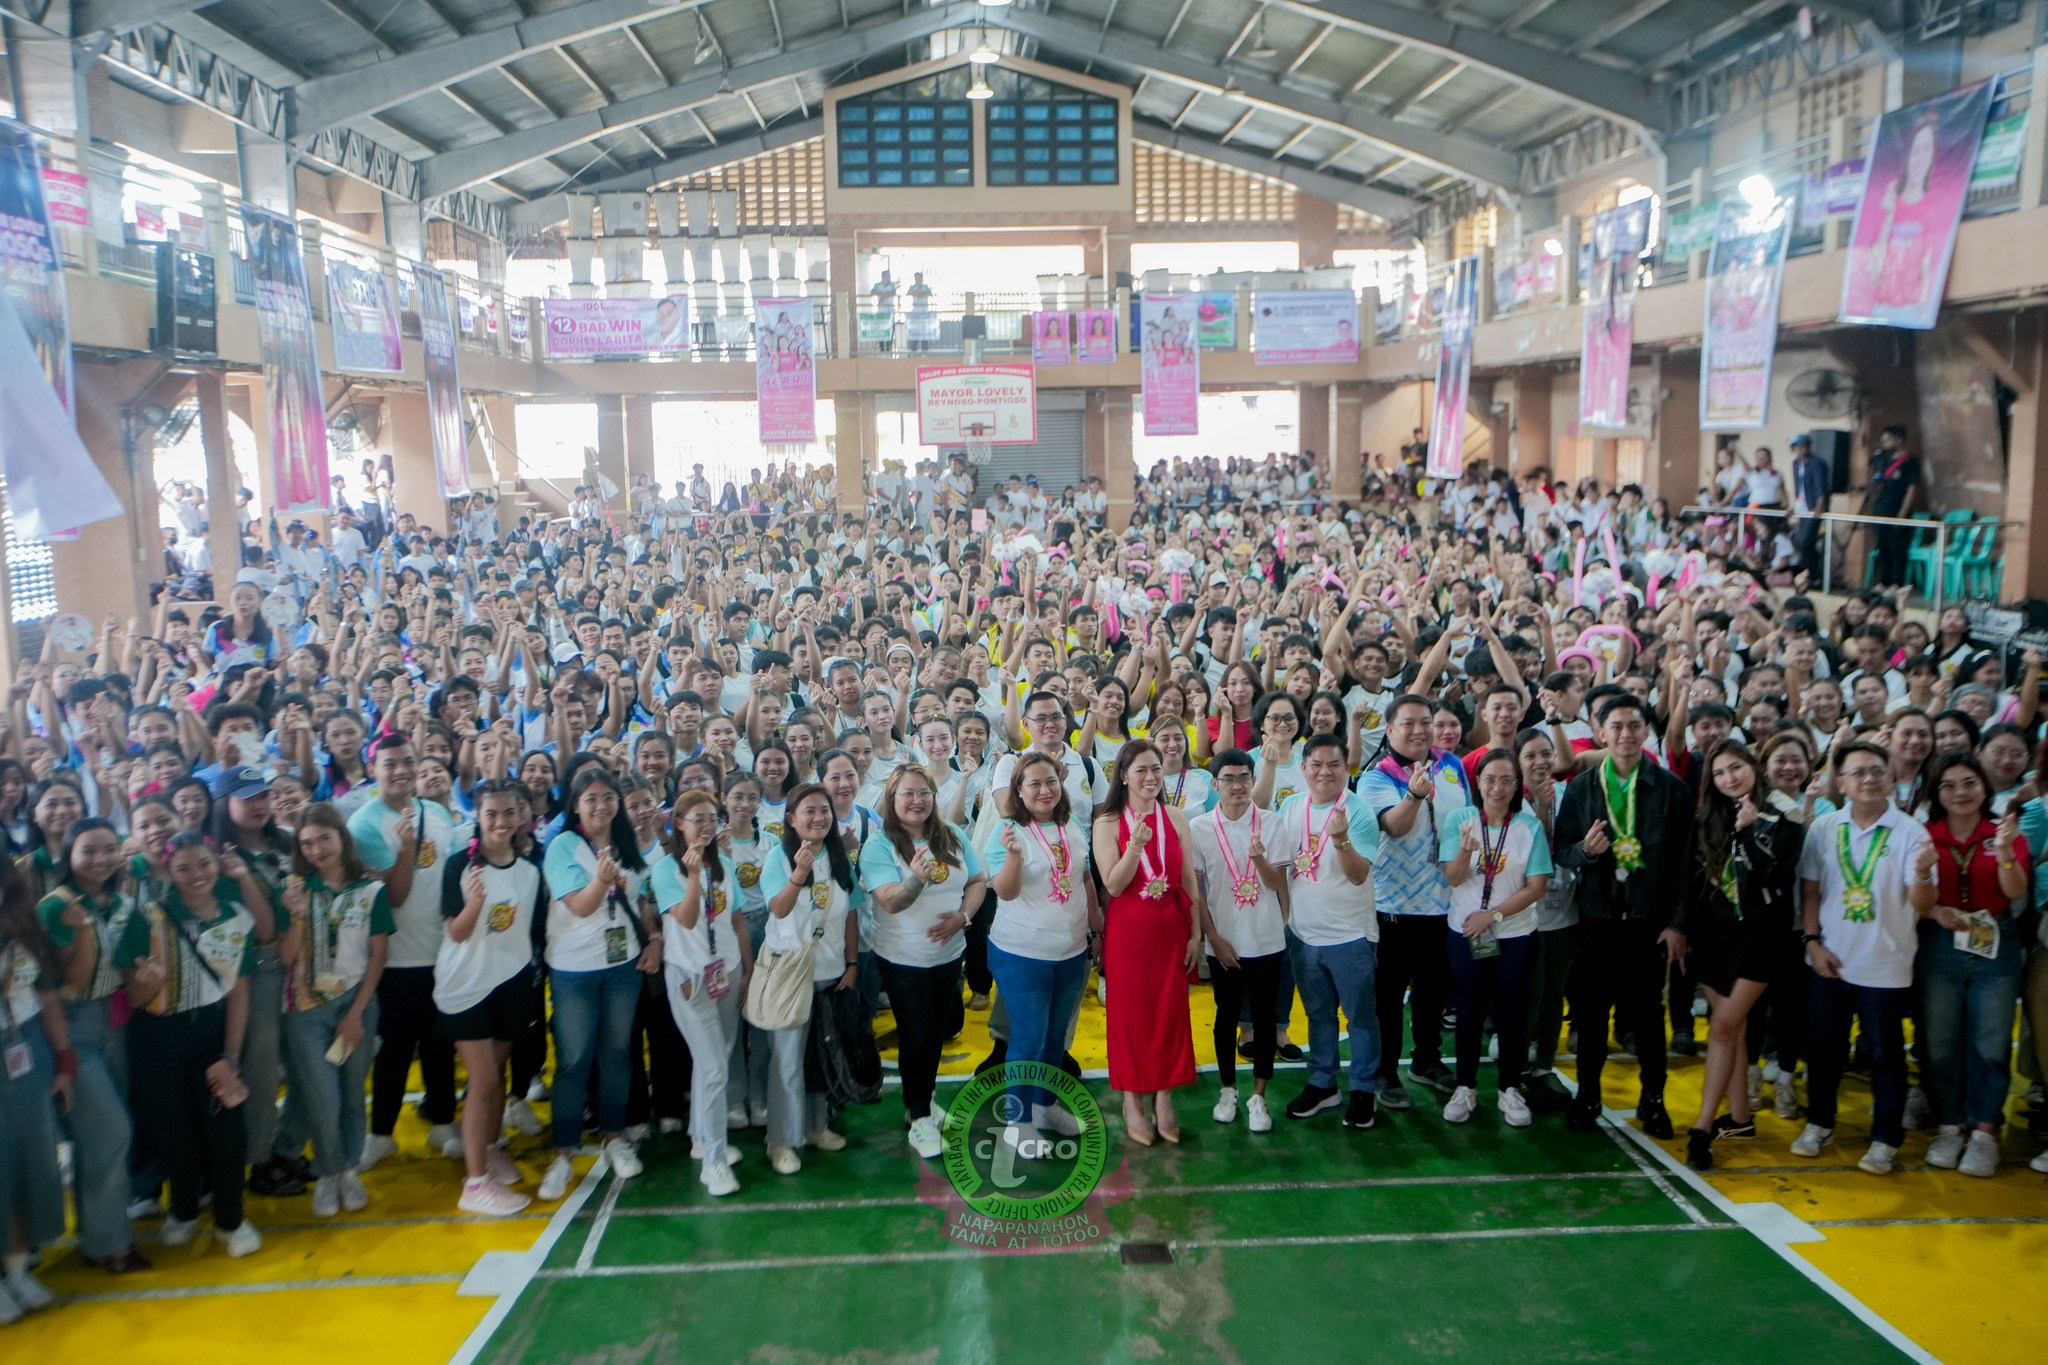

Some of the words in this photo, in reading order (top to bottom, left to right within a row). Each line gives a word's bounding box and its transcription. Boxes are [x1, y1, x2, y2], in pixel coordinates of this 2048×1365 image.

[554, 319, 573, 334] 12
[930, 388, 974, 399] MAYOR
[978, 386, 1024, 397] LOVELY
